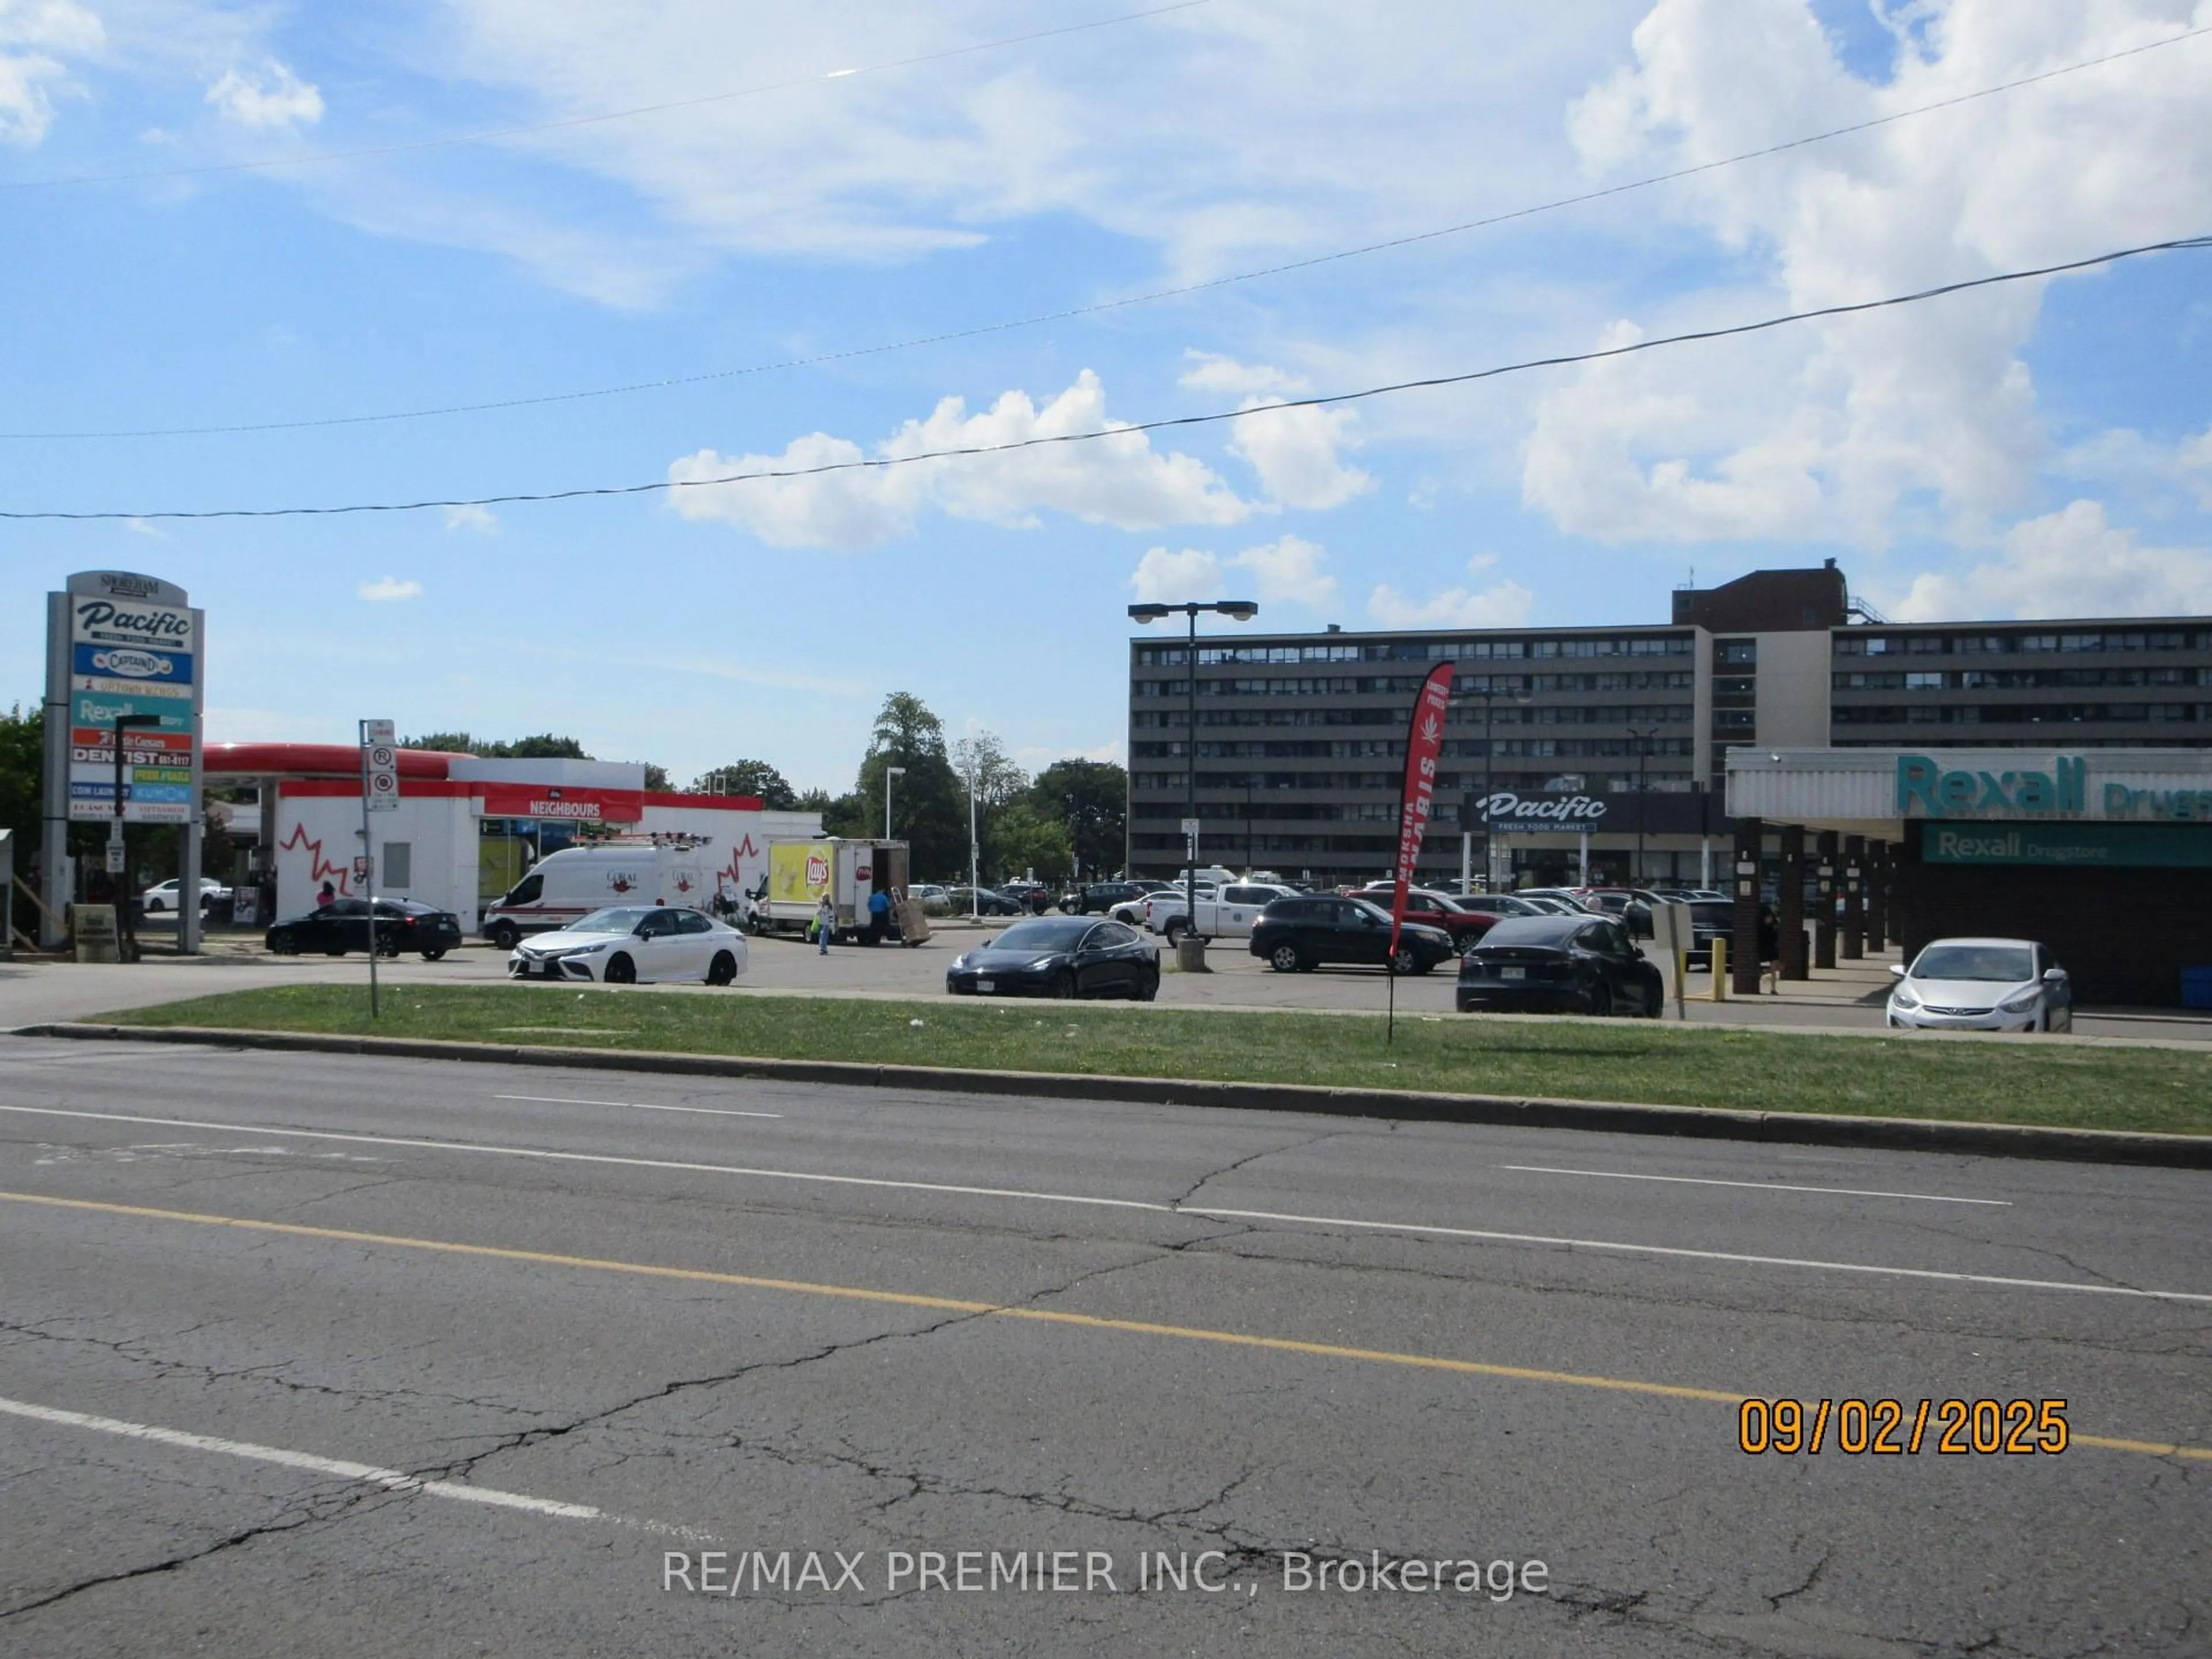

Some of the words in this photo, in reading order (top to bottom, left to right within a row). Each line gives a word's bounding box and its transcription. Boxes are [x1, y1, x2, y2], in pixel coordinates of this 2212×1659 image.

[77, 601, 191, 635] Pacific
[81, 699, 134, 722] Rexall
[73, 749, 158, 764] DENIST
[1897, 756, 2086, 818] Rexall
[1476, 792, 1607, 822] Pacific
[1399, 802, 1414, 882] MOKSHA
[1939, 831, 2021, 858] Rexall
[2027, 843, 2107, 861] Drugstore
